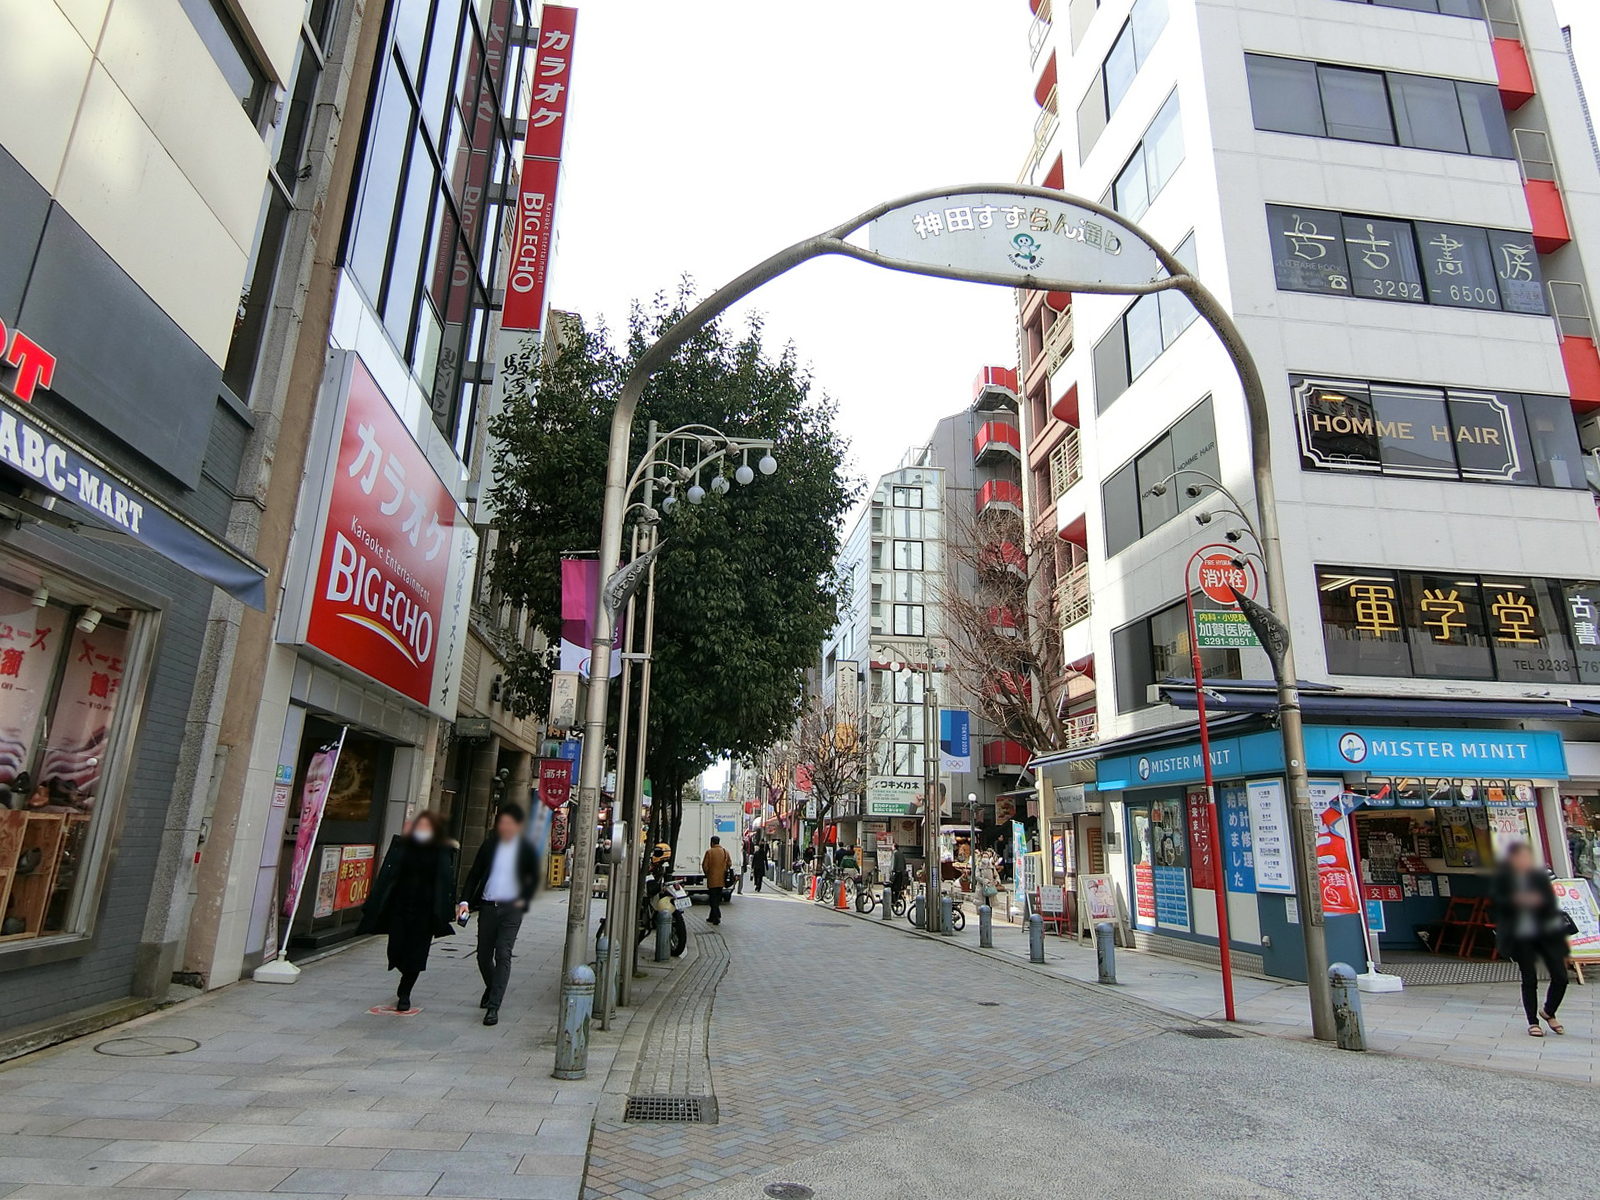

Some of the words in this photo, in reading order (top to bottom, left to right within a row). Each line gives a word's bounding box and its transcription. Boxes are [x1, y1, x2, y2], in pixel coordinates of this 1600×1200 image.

[533, 30, 570, 128] カラオケ
[543, 202, 553, 230] Karaoke
[912, 204, 1123, 257] 神田すずらん通り
[537, 232, 550, 284] Entertainment
[1029, 256, 1045, 271] STREET
[1313, 414, 1413, 441] HOMME
[1431, 424, 1501, 445] HAIR
[0, 410, 143, 534] ABC-MART
[1177, 453, 1199, 472] HOMME
[1200, 441, 1215, 457] HAIR
[349, 422, 446, 561] カラオケ
[351, 515, 384, 556] Karaoke
[385, 549, 431, 603] Entertainment
[1202, 568, 1245, 588] 消火栓
[1198, 623, 1252, 637] 加賀医院
[1350, 584, 1540, 644] 軍学堂
[1568, 595, 1597, 645] 古書
[1204, 637, 1250, 646] 3291-9951
[1513, 659, 1535, 671] TEL
[1152, 756, 1190, 773] MISTER
[1372, 740, 1456, 757] MISTER
[1462, 743, 1528, 759] MINIT
[1198, 794, 1209, 866] クリーニング
[1226, 792, 1244, 887] 始めました
[1237, 792, 1254, 868] 時計修理
[350, 878, 369, 902] OK!
